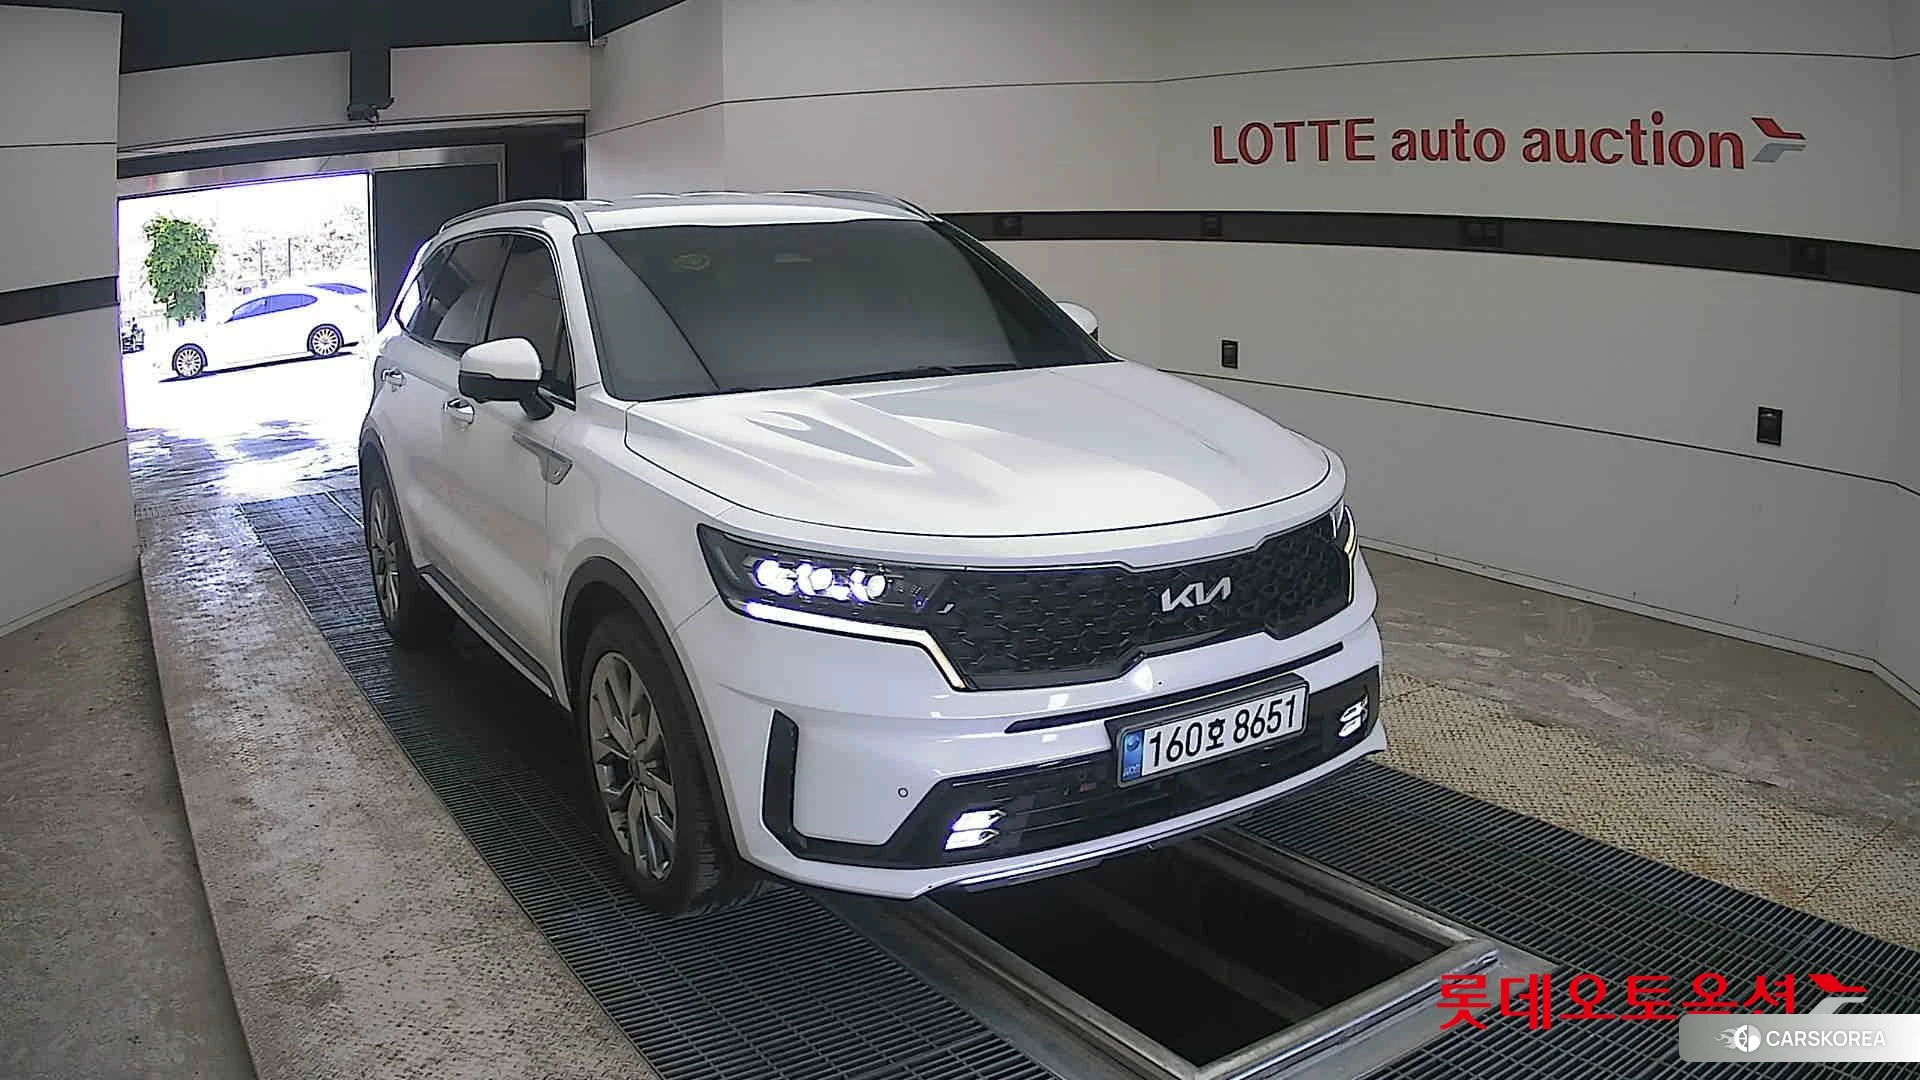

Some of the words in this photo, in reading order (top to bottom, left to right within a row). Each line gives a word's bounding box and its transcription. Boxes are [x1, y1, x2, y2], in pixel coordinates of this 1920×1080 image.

[1213, 118, 1376, 165] LOTTE
[1391, 118, 1506, 163] auto
[1522, 110, 1745, 169] auction
[1161, 576, 1232, 612] KIA
[1232, 694, 1297, 745] 8651
